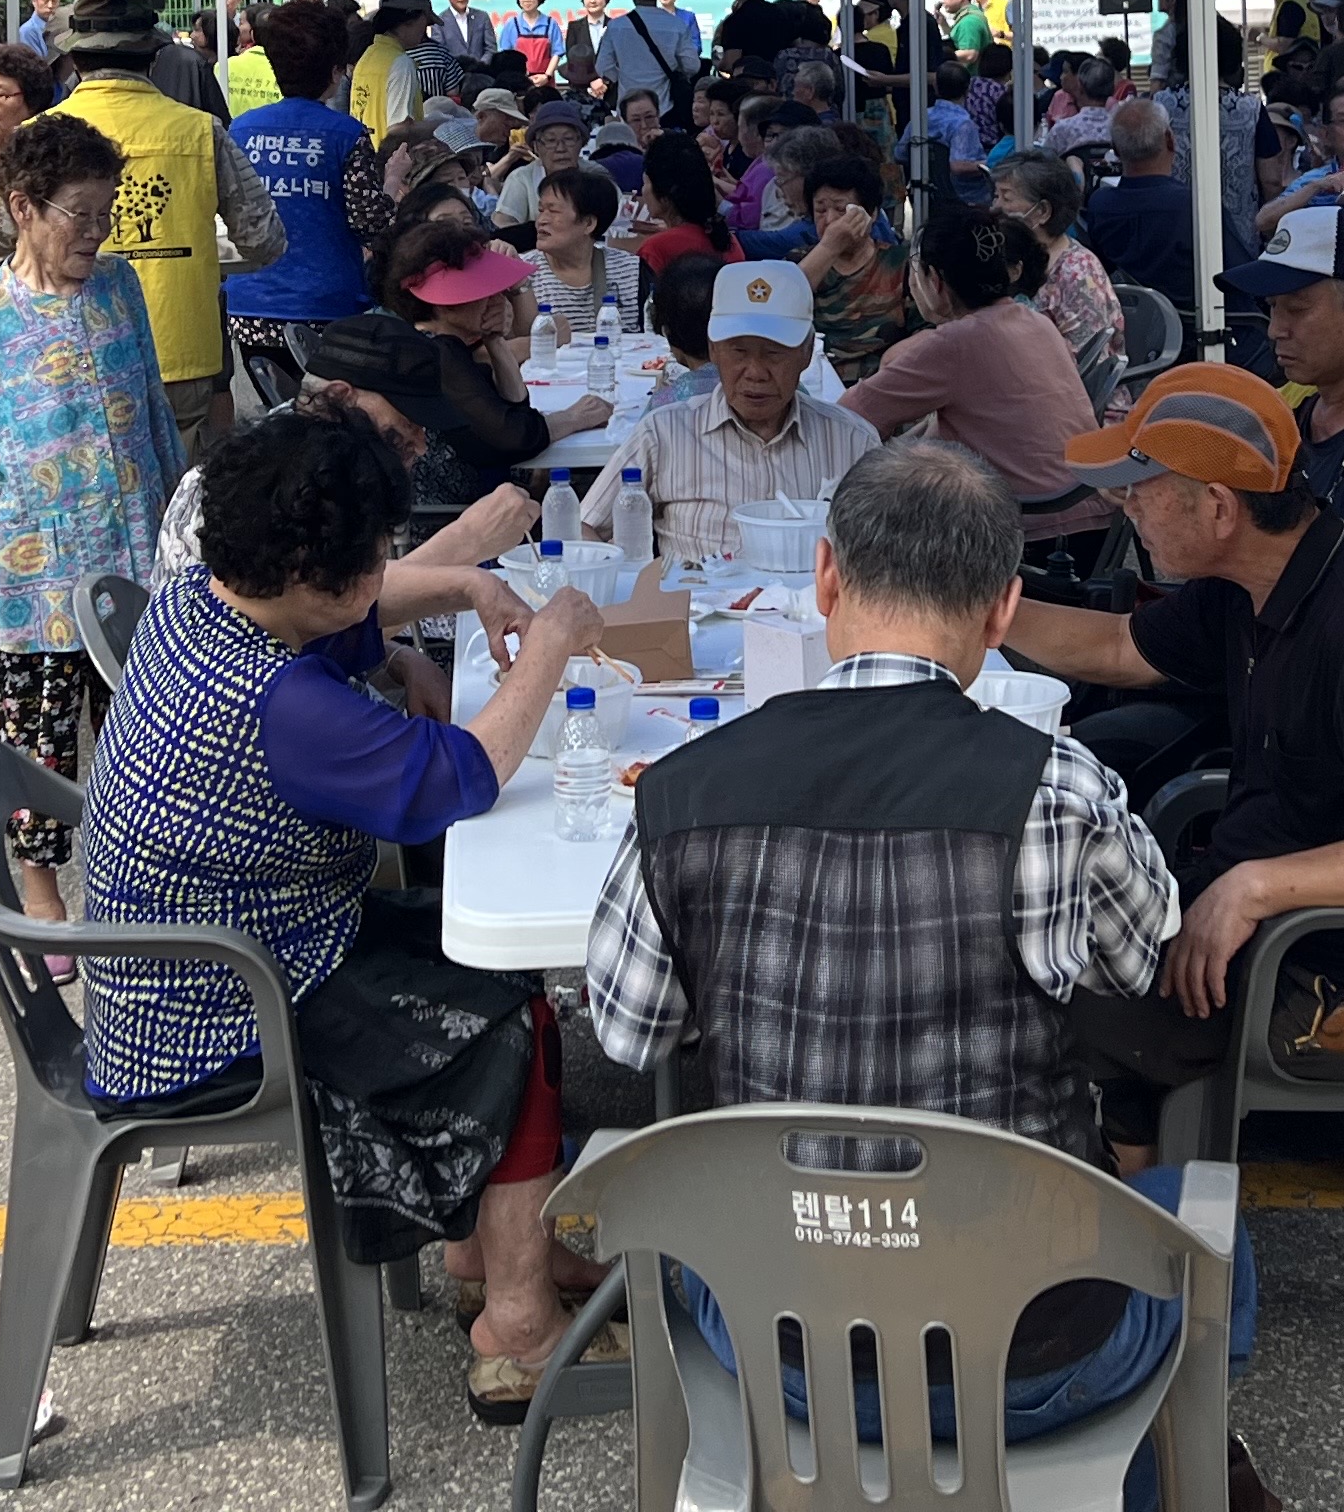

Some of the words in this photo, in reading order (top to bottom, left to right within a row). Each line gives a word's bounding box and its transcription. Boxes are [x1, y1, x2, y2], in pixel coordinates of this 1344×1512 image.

[245, 134, 325, 167] 생명존중
[792, 1190, 919, 1231] 렌탈114
[795, 1226, 921, 1248] 010-3742-3303
